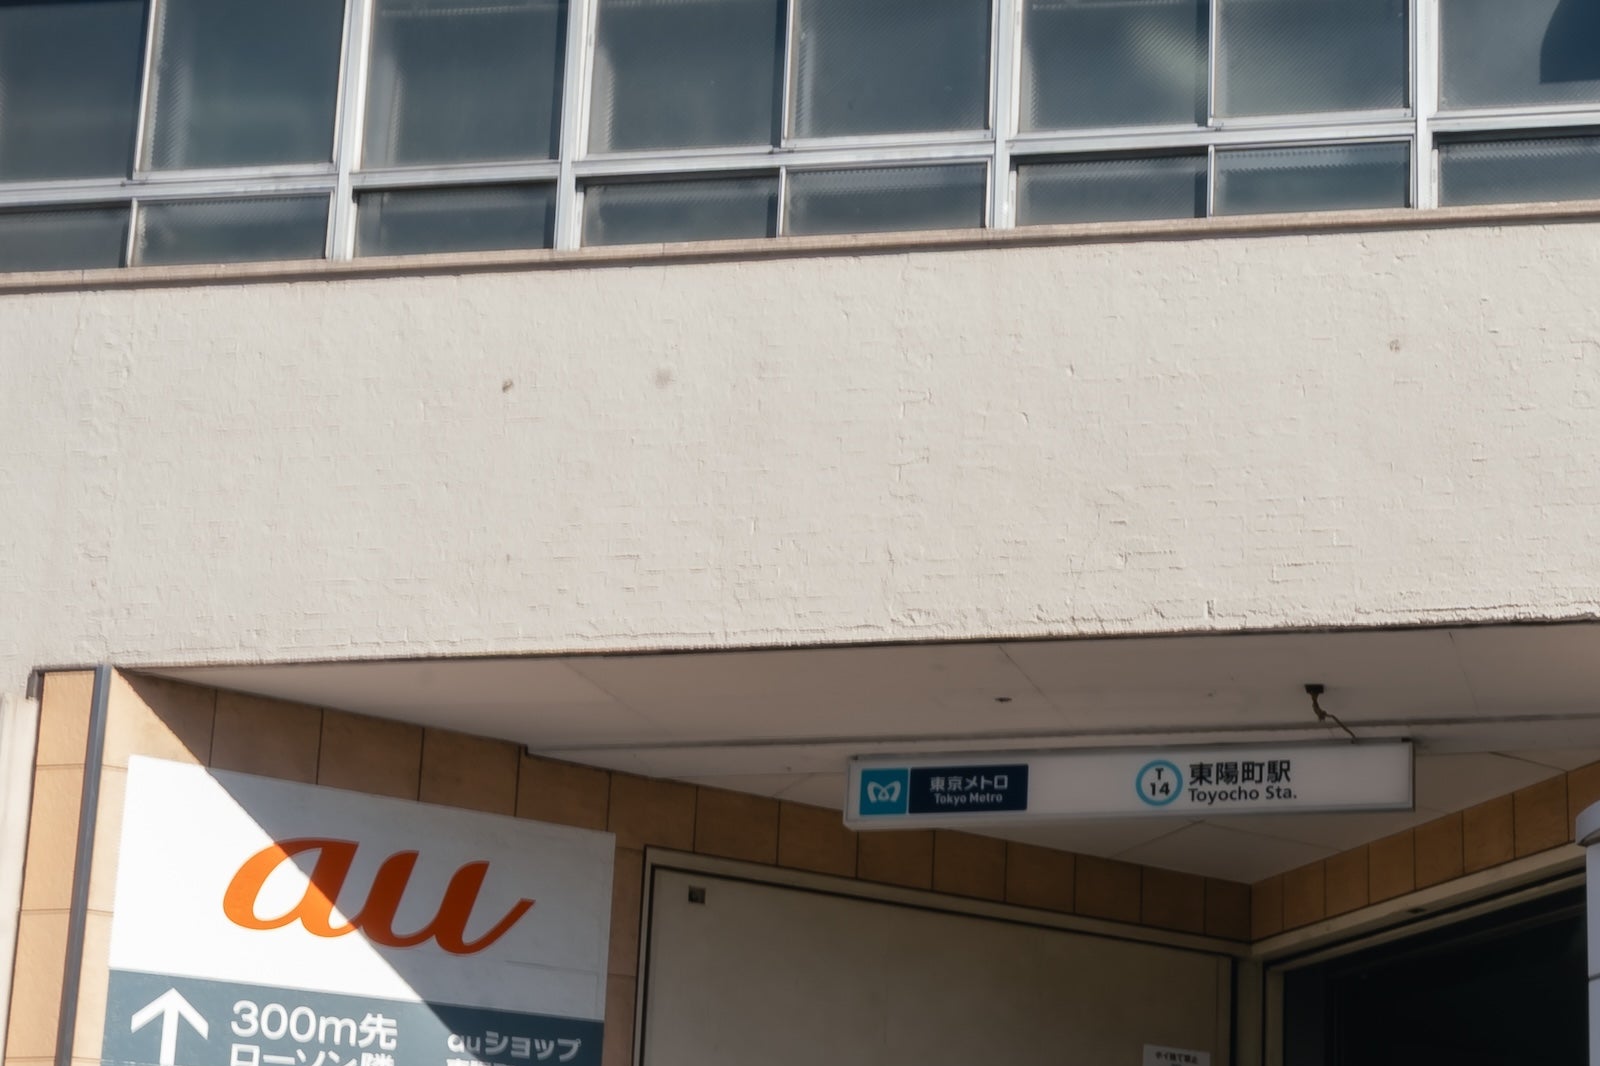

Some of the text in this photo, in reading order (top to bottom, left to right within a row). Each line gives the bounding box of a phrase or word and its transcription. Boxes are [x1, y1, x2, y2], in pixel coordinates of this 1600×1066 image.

[1155, 768, 1164, 780] T
[1188, 759, 1292, 785] 東陽町駅
[929, 774, 1009, 792] 東京メトロ
[1149, 783, 1170, 796] 14
[934, 791, 1003, 805] Tokyo Metro
[1188, 784, 1298, 805] Toyocho Sta.
[223, 837, 536, 955] au
[230, 1000, 398, 1051] 300m先
[446, 1031, 582, 1061] auショップ
